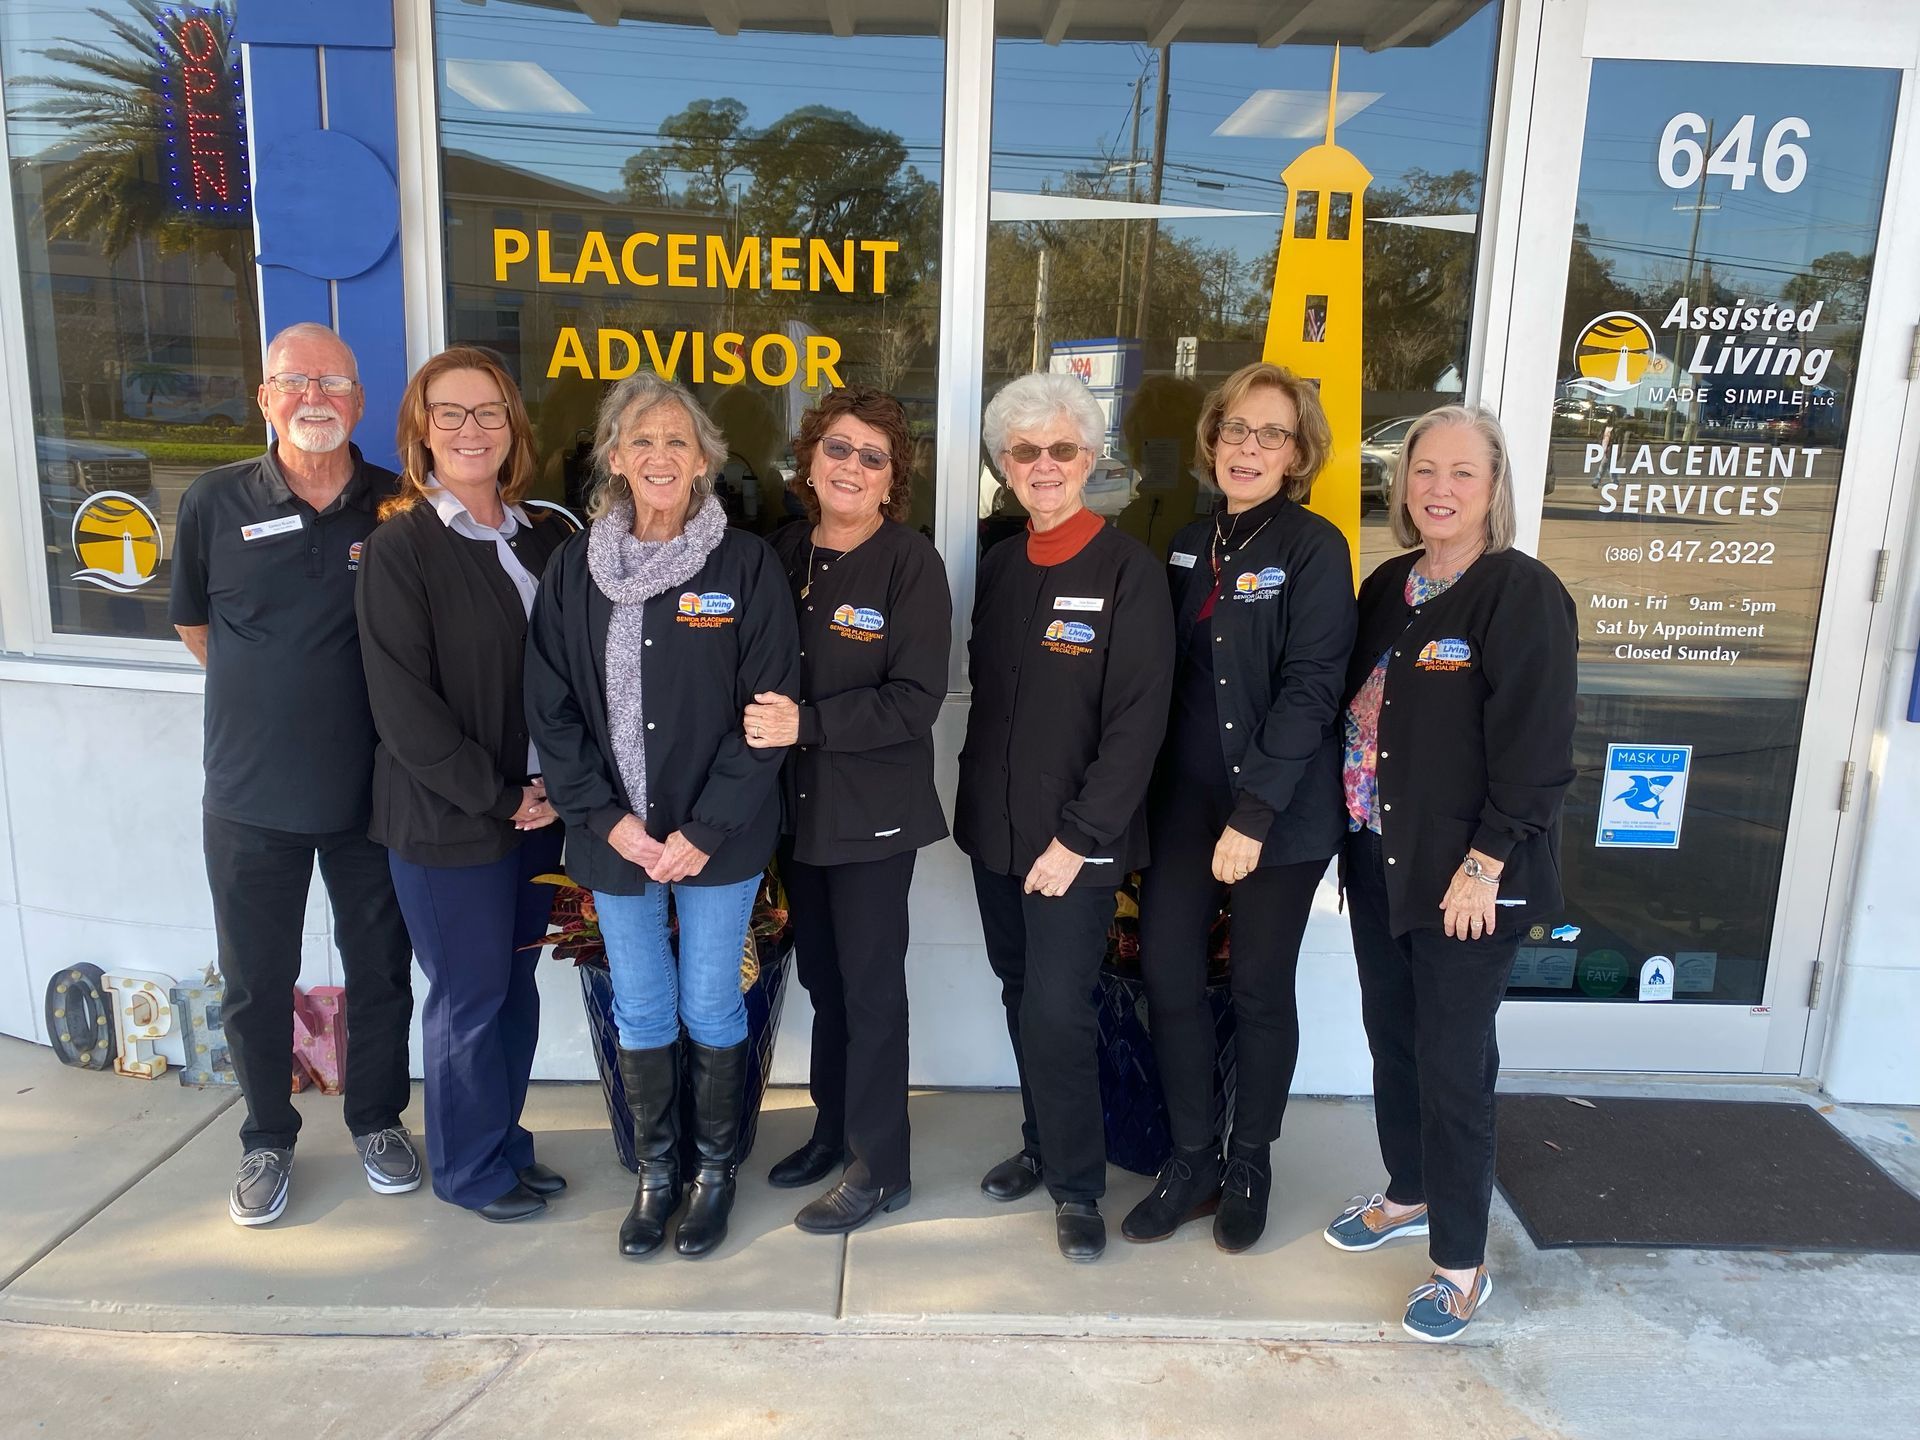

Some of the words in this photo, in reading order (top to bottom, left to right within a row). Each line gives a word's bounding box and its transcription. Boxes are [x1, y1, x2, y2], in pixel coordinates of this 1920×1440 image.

[180, 19, 229, 201] OPEN
[1658, 112, 1811, 193] 646
[493, 228, 899, 294] PLACEMENT
[1661, 297, 1824, 332] Assisted
[546, 327, 846, 388] ADVISOR
[1688, 335, 1834, 386] Living
[1649, 388, 1709, 403] MADE
[1724, 388, 1809, 407] SIMPLE,
[1813, 397, 1835, 406] LLC
[1583, 443, 1822, 478] PLACEMENT
[1598, 483, 1782, 517] SERVICES
[1605, 546, 1643, 564] (386)
[1648, 539, 1776, 565] 847.2322
[707, 600, 732, 609] Living
[1590, 595, 1628, 609] Mon
[1646, 596, 1668, 610] Fri
[1689, 597, 1723, 612] 9am
[1741, 598, 1777, 616] 5pm
[1068, 629, 1092, 640] Living
[1596, 620, 1622, 635] Sat
[1628, 621, 1648, 639] by
[1652, 622, 1764, 640] Appointment
[1443, 645, 1469, 655] Living
[1615, 644, 1672, 661] Closed
[1678, 647, 1740, 665] Sunday
[1618, 752, 1656, 763] MASK
[1661, 753, 1680, 764] UP
[1586, 970, 1619, 983] FAVE
